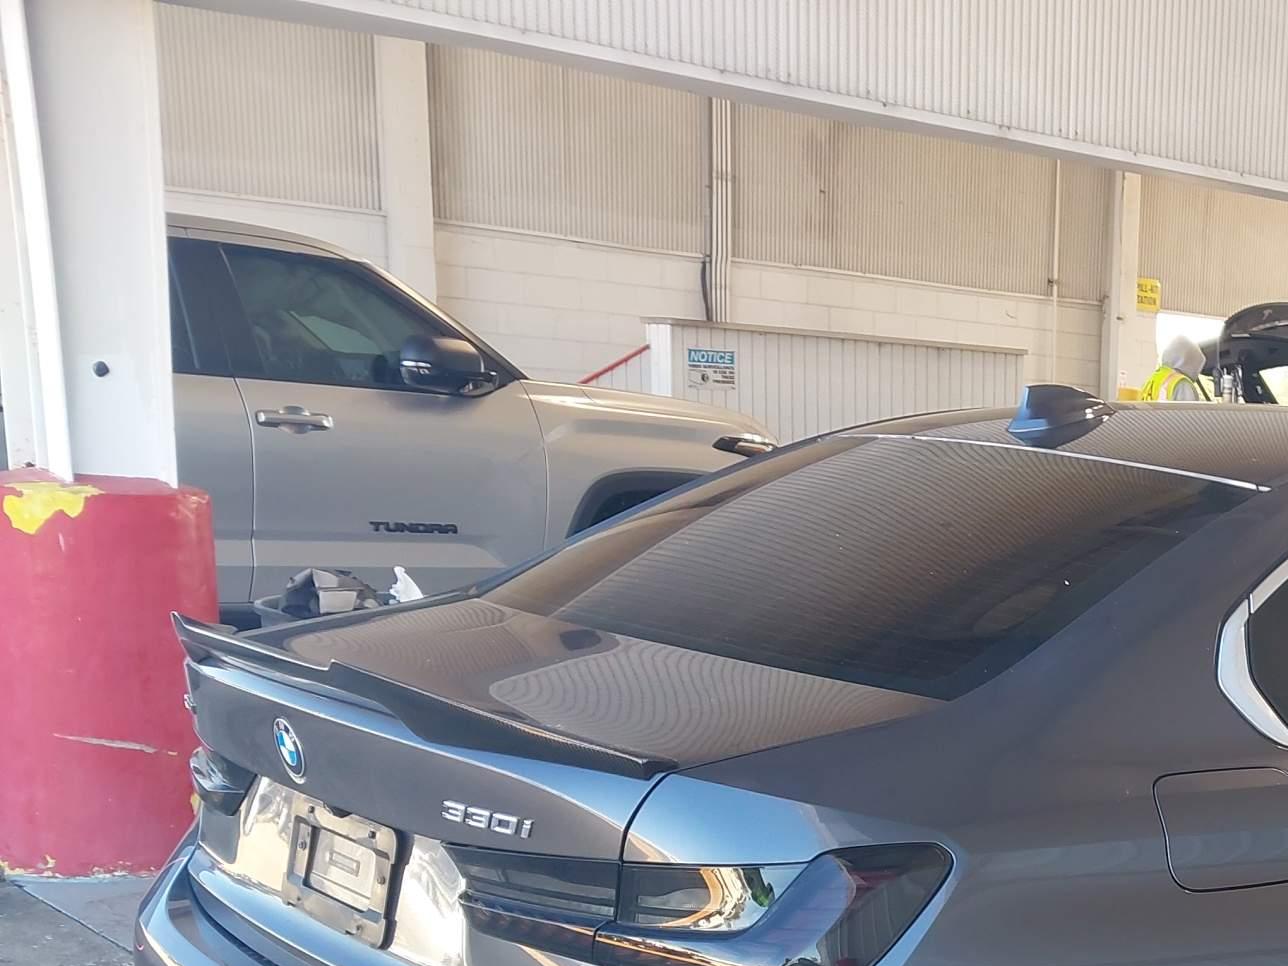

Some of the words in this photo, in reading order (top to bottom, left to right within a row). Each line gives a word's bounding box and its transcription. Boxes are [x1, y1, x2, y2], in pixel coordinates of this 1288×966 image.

[690, 350, 733, 364] NOTICE
[369, 521, 458, 534] TUNDRA
[441, 800, 534, 839] 330i
